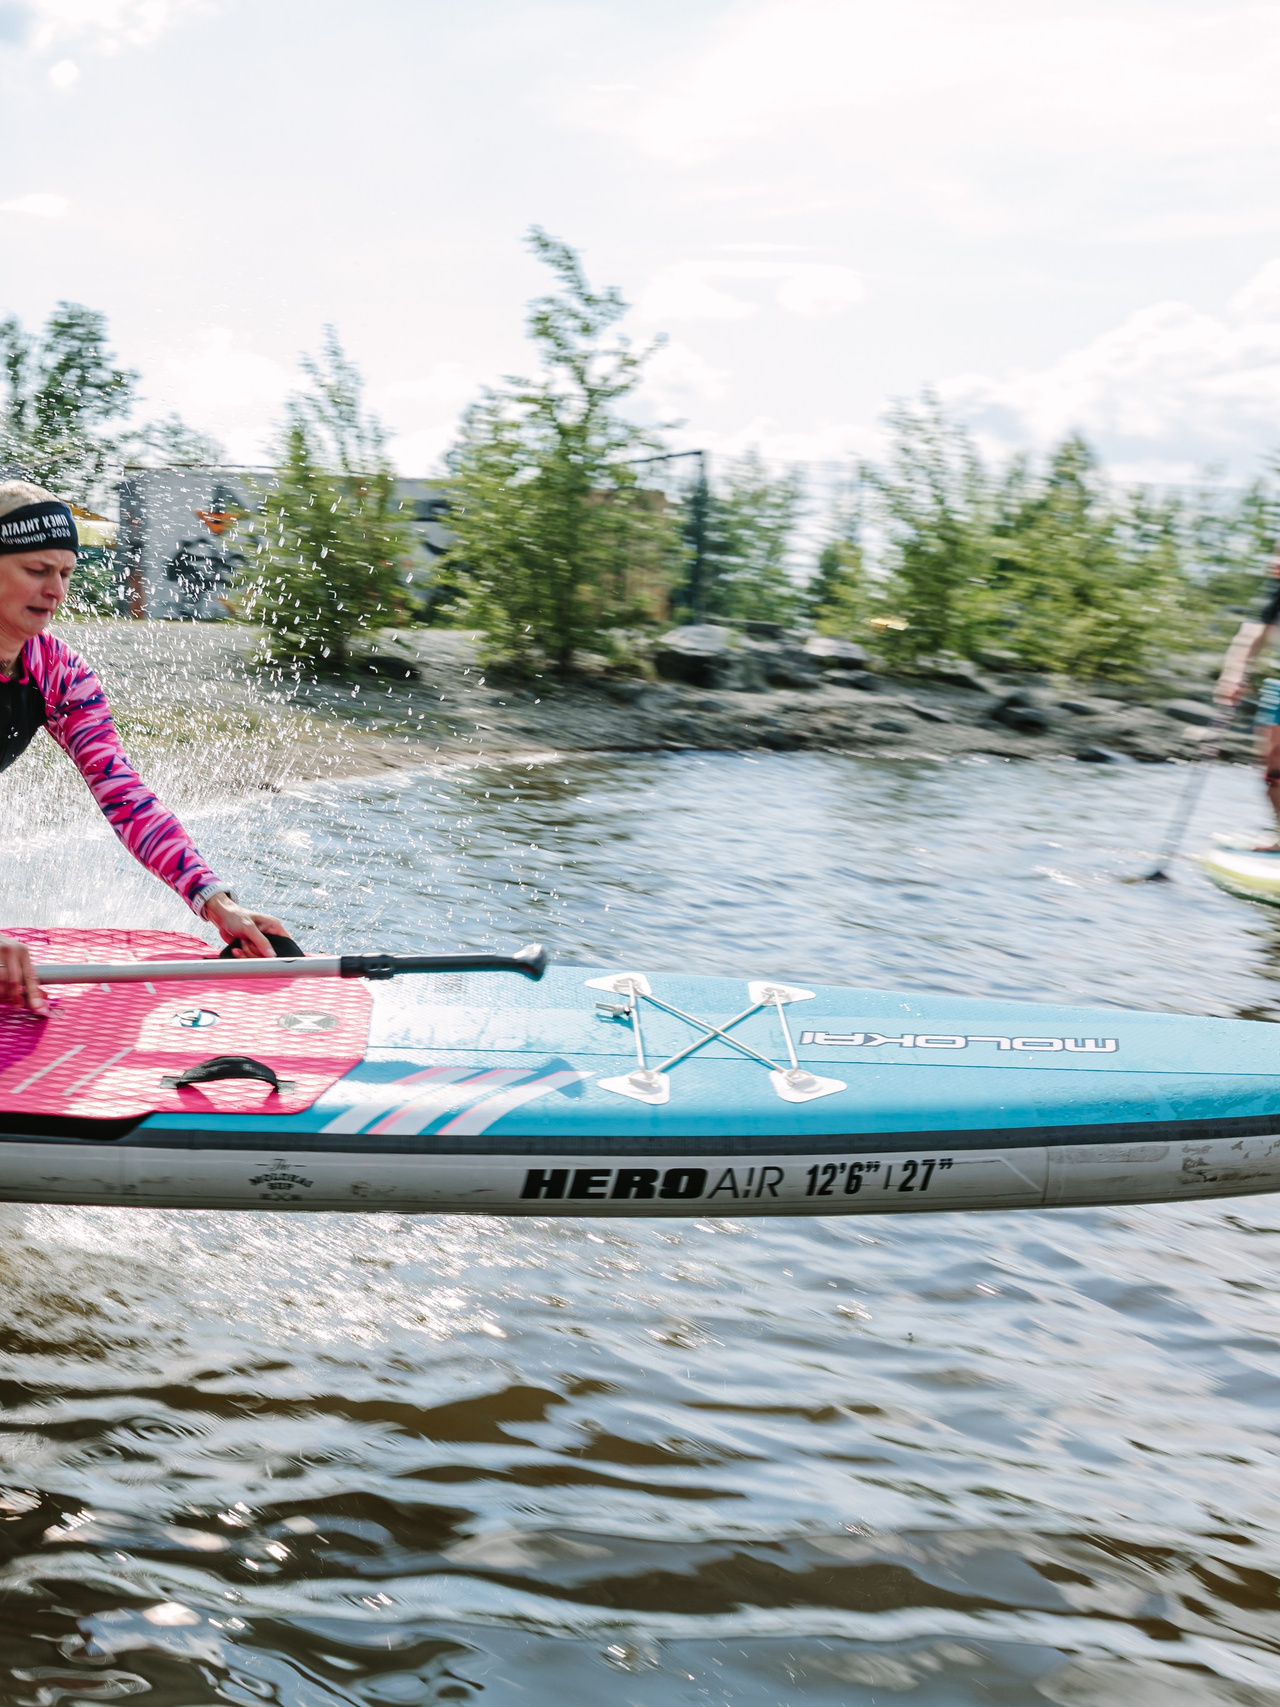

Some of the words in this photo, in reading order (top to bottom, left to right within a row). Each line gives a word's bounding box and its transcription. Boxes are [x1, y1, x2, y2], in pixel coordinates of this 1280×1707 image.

[1, 518, 40, 538] АТЛАНТ
[42, 514, 70, 529] КЭМП
[799, 1030, 1120, 1053] MOLOKAI
